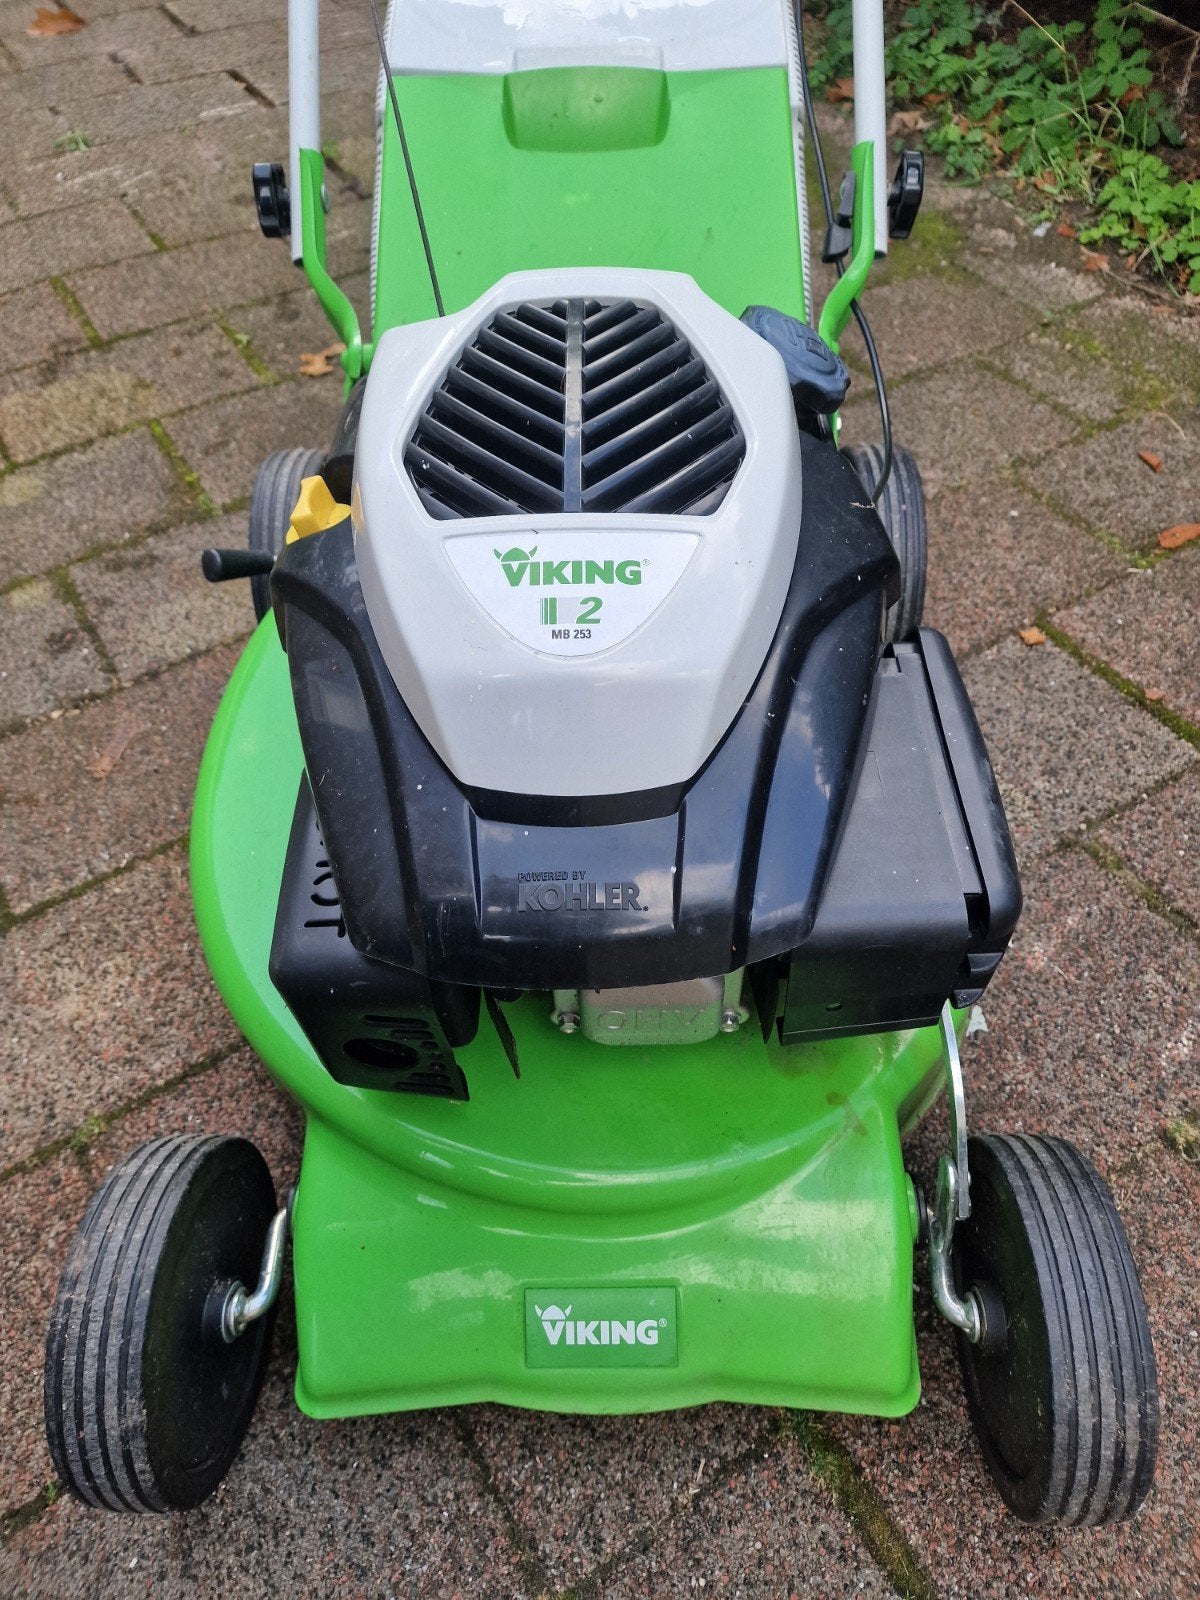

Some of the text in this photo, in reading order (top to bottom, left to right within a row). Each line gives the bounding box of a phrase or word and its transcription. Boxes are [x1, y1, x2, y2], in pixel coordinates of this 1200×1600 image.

[551, 629, 592, 640] MB 253
[517, 870, 587, 882] POWERED BY
[598, 1010, 705, 1030] OHV
